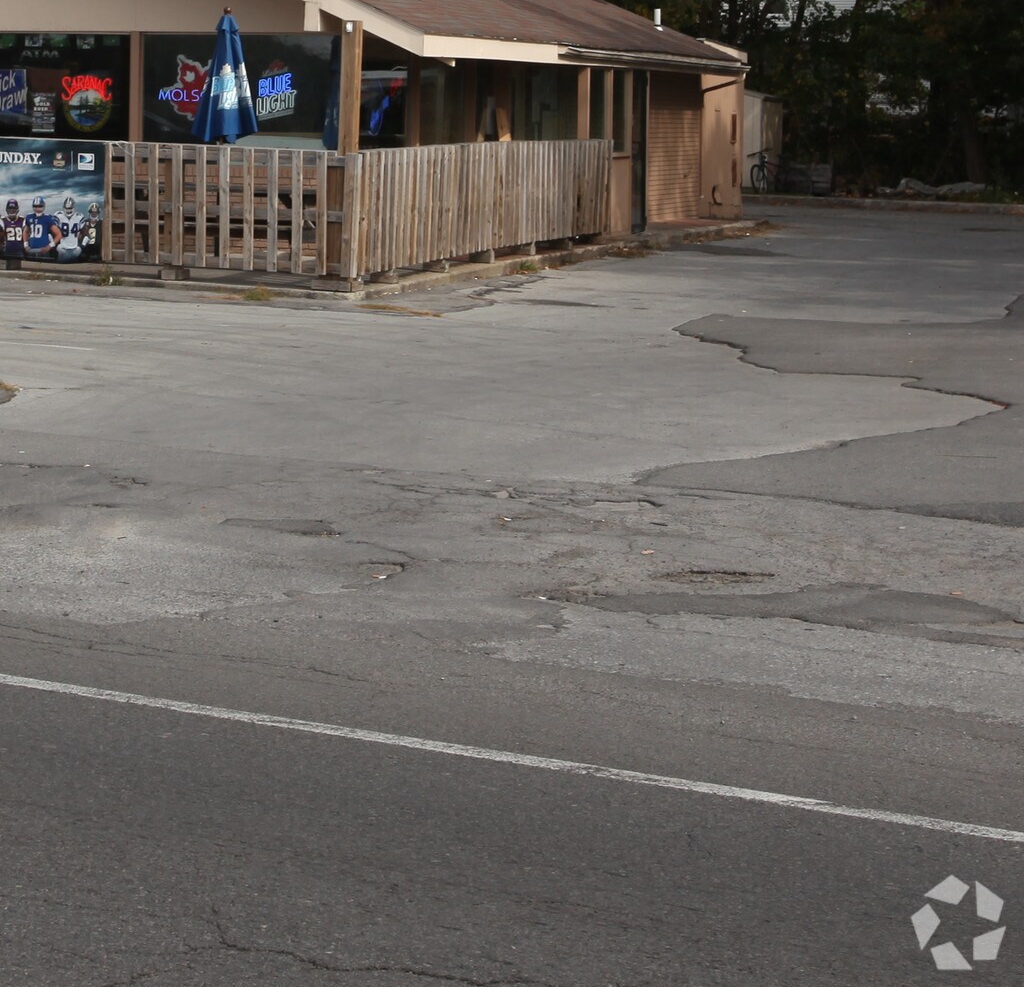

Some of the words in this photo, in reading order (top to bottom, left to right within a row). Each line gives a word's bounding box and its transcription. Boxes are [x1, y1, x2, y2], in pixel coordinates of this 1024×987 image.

[61, 75, 113, 101] SARANAC
[258, 72, 292, 98] BLUE
[256, 89, 297, 116] LIGHT
[5, 226, 23, 242] 28
[29, 224, 43, 239] 10
